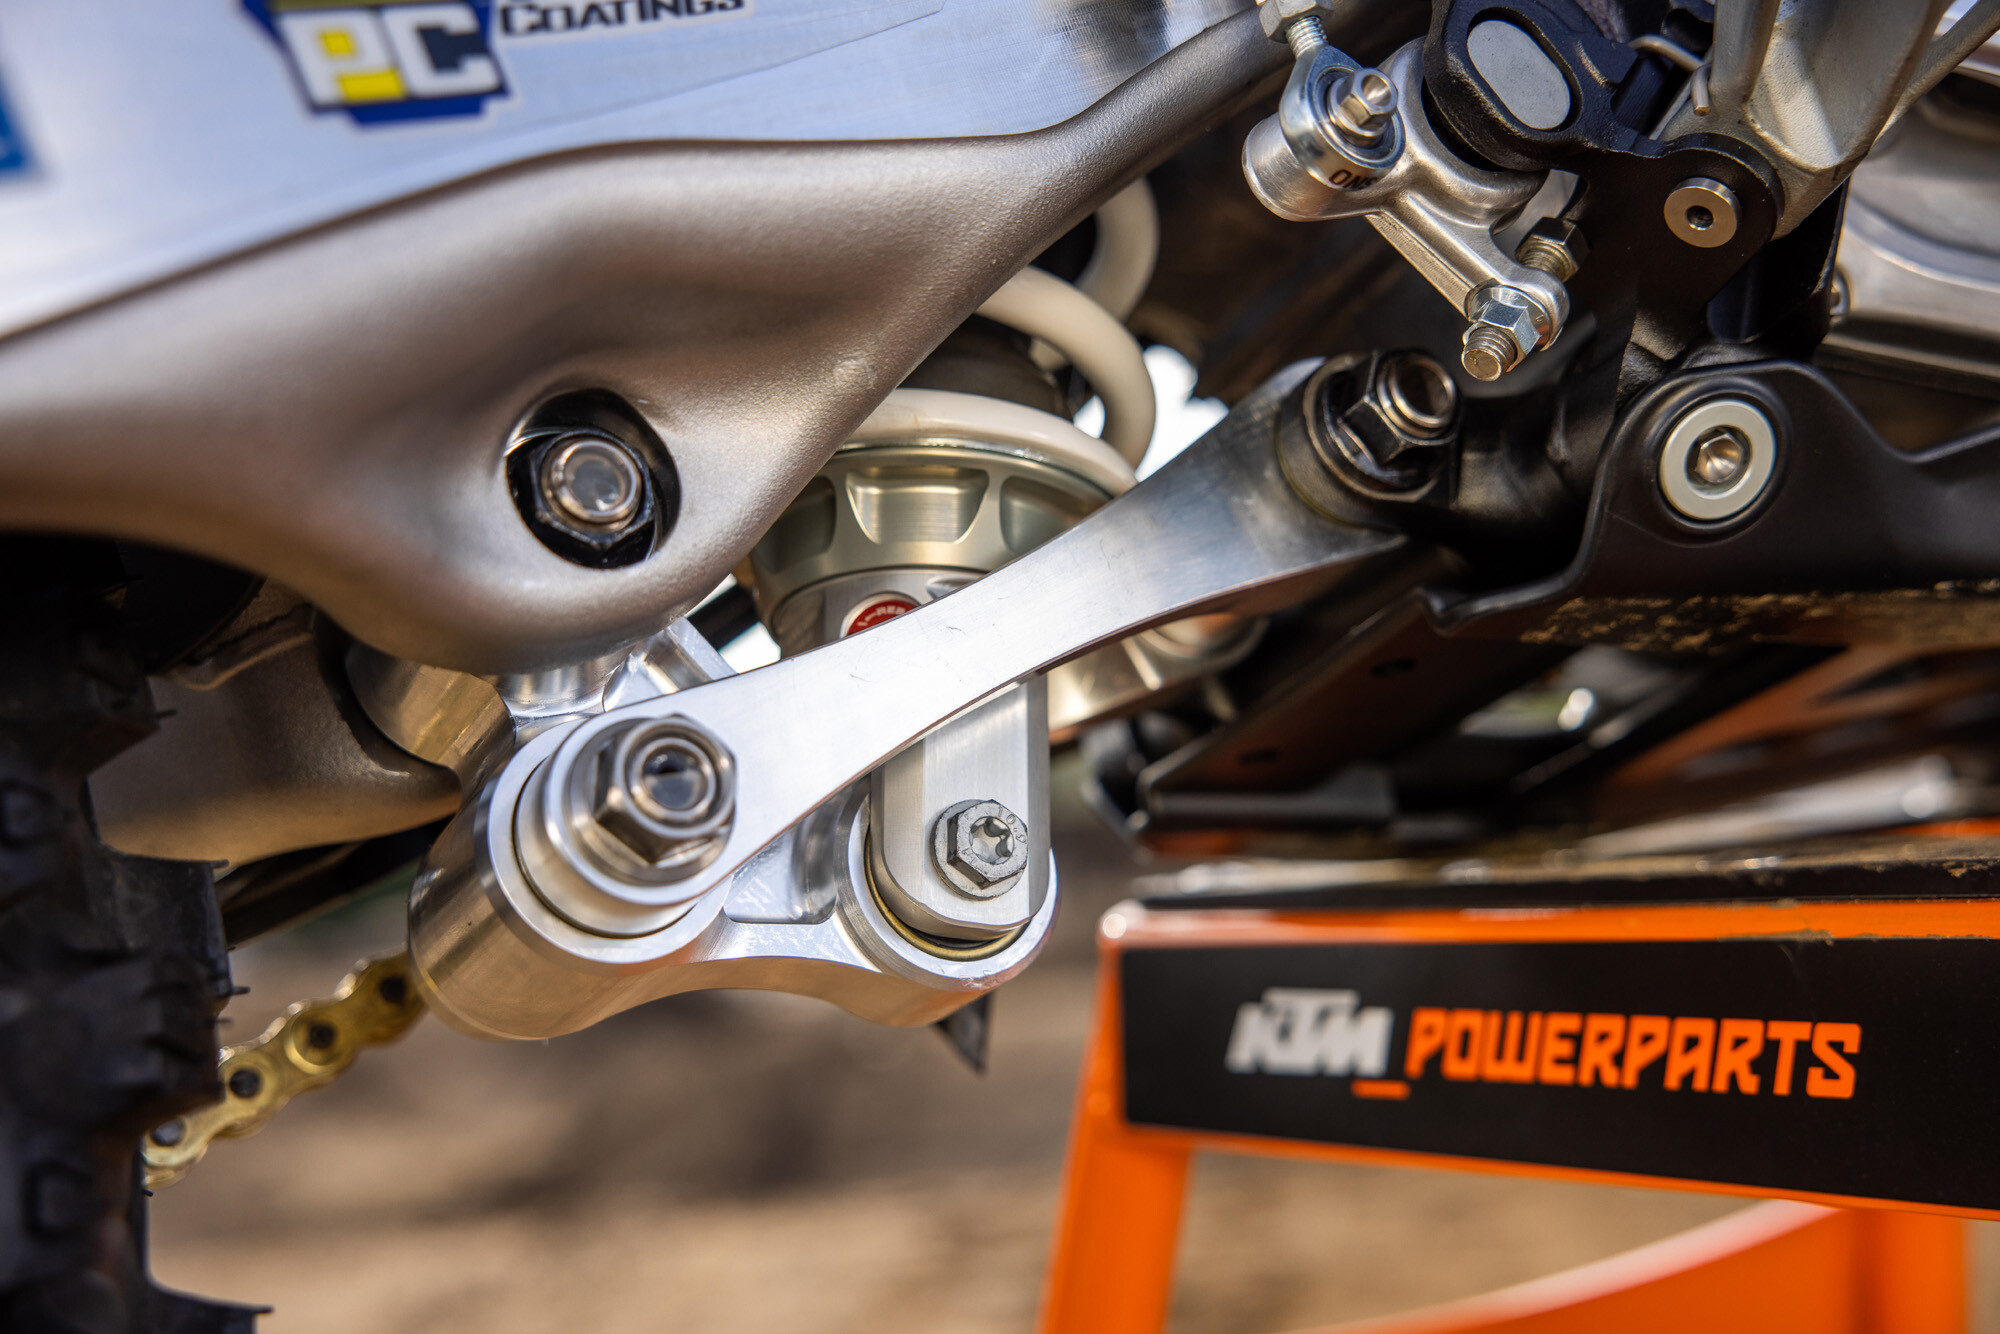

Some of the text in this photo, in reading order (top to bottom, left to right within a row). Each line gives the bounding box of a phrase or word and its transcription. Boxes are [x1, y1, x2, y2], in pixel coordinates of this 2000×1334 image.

[277, 3, 501, 104] PC
[1225, 987, 1862, 1099] KTM POWERPARTS
